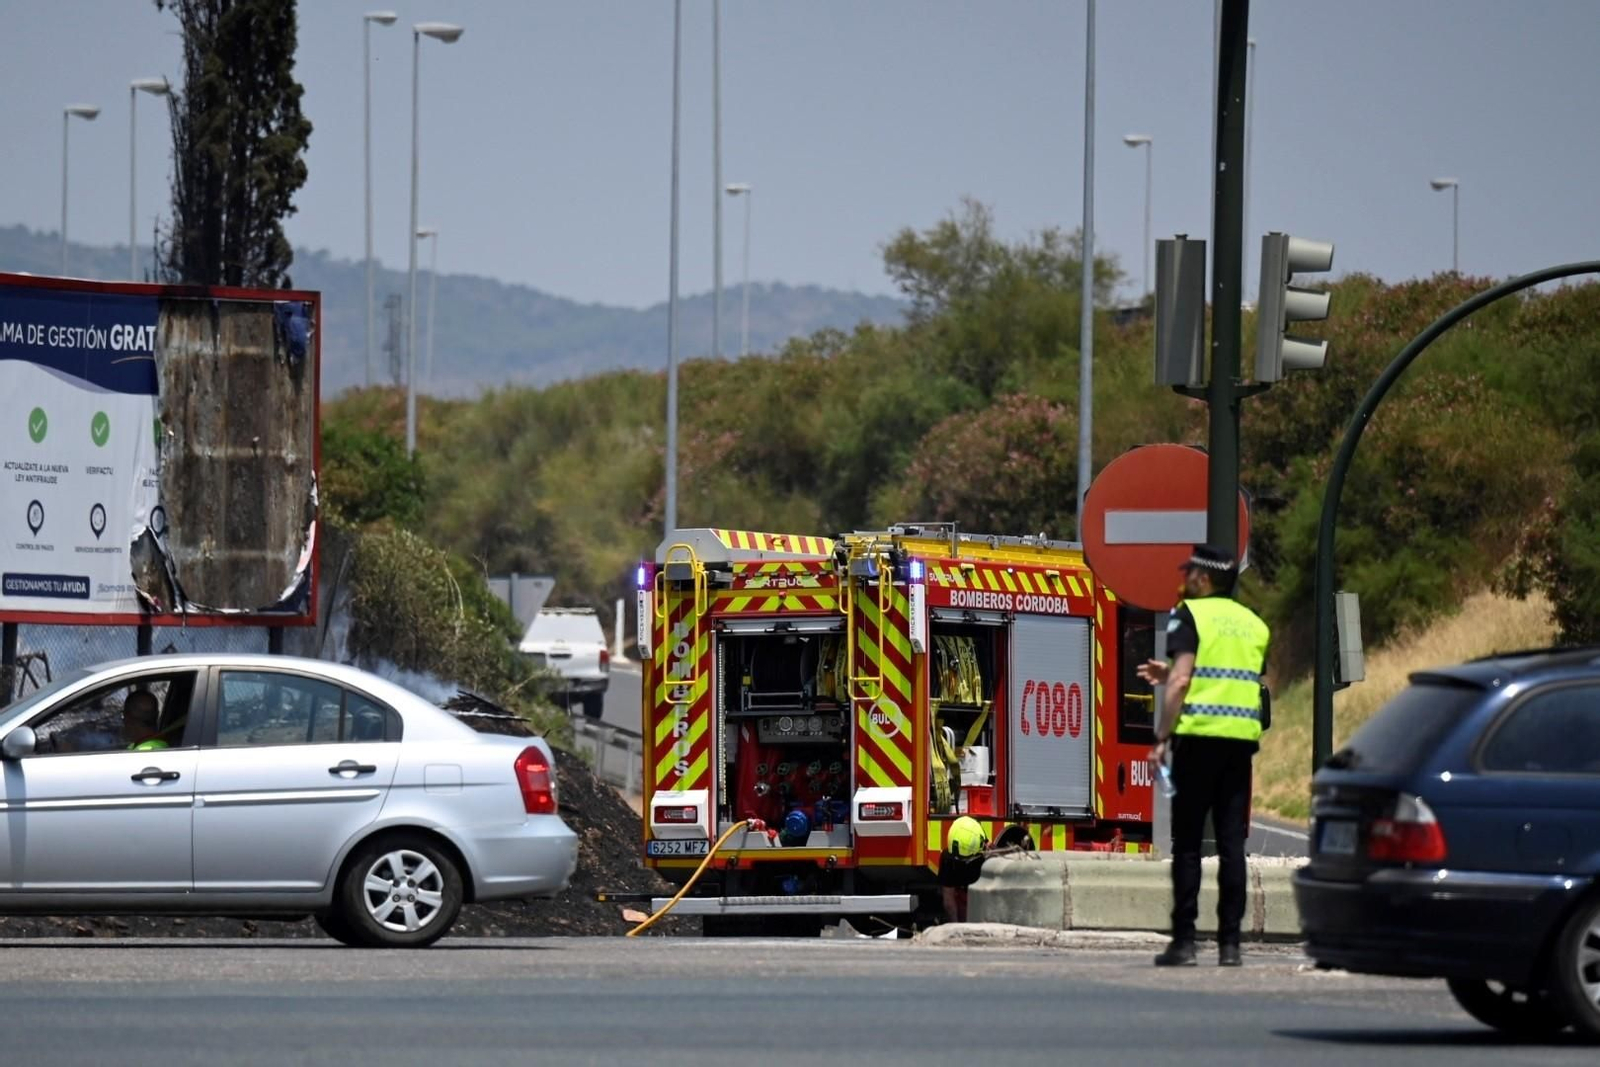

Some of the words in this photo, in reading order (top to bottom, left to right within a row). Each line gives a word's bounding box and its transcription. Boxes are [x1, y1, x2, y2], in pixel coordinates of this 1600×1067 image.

[27, 324, 45, 345] DE
[48, 325, 107, 349] GESTIÓN
[110, 324, 157, 351] GRAT
[5, 578, 53, 592] GESTIONAMOS
[53, 581, 62, 592] TU
[62, 581, 87, 593] AYUDA
[951, 590, 1013, 610] BOMBEROS
[672, 622, 691, 777] BOMBEROS
[1035, 681, 1082, 738] 080
[653, 841, 681, 854] 6252
[684, 841, 707, 854] MFZ
